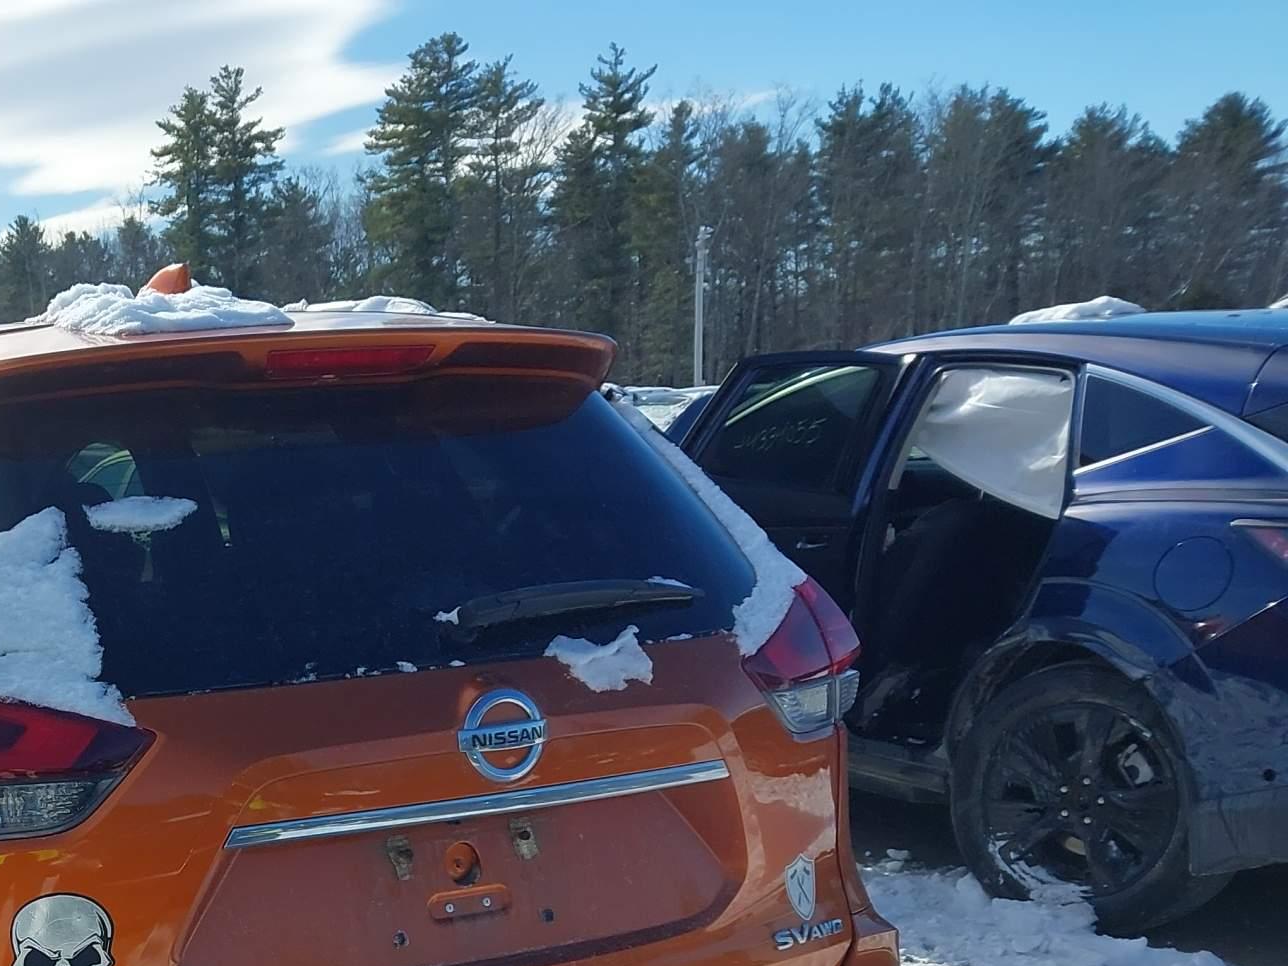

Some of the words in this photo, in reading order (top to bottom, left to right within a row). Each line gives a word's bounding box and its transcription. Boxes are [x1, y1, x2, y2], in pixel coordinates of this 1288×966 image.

[471, 725, 543, 748] NISSAN
[774, 922, 809, 951] SV
[811, 918, 843, 941] AWD
